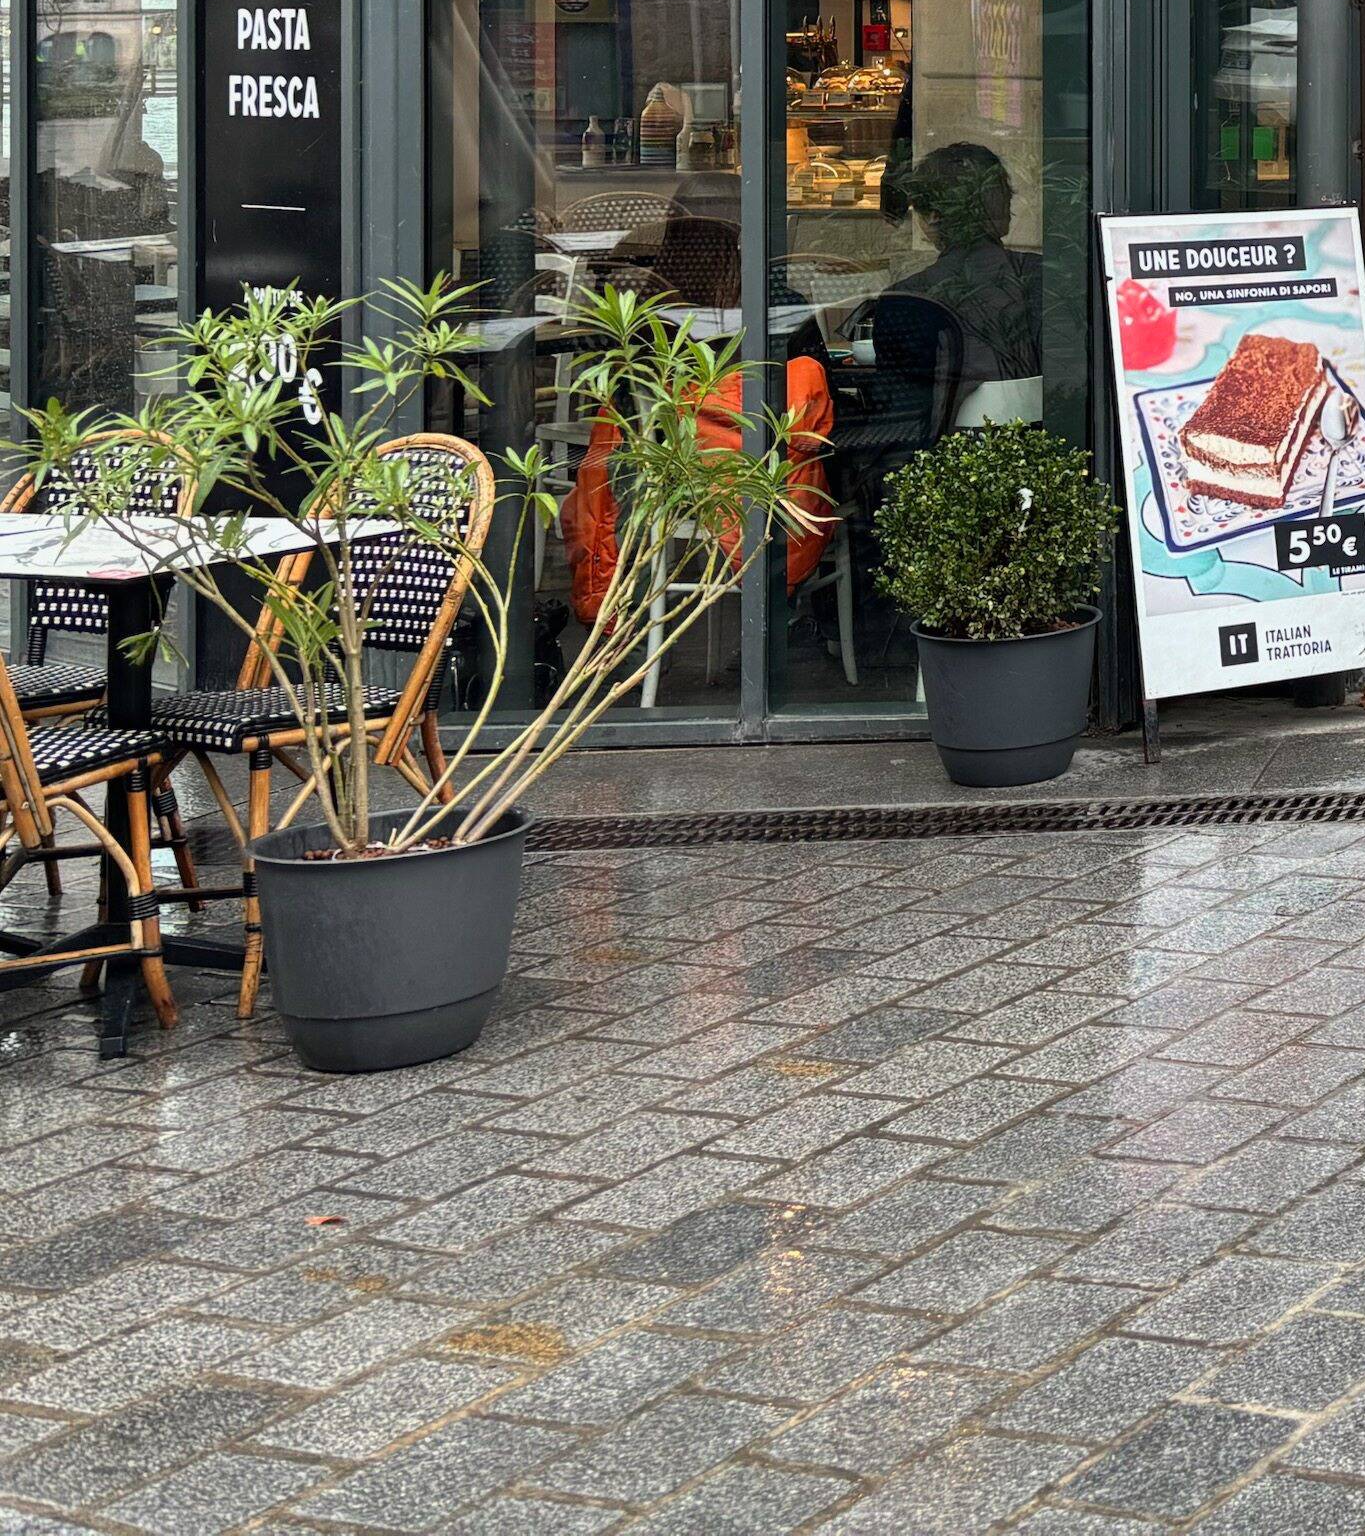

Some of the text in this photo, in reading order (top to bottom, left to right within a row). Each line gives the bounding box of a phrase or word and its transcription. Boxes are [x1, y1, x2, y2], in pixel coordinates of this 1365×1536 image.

[237, 7, 310, 52] PASTA
[228, 75, 320, 120] FRESCA
[1138, 243, 1297, 272] UNE DOUCEUR ?
[1175, 283, 1332, 302] NO, UNA SINFONIA DI SAPORI
[1229, 633, 1248, 656] IT
[1265, 624, 1312, 644] ITALIAN
[1266, 639, 1333, 661] TRATTORIA
